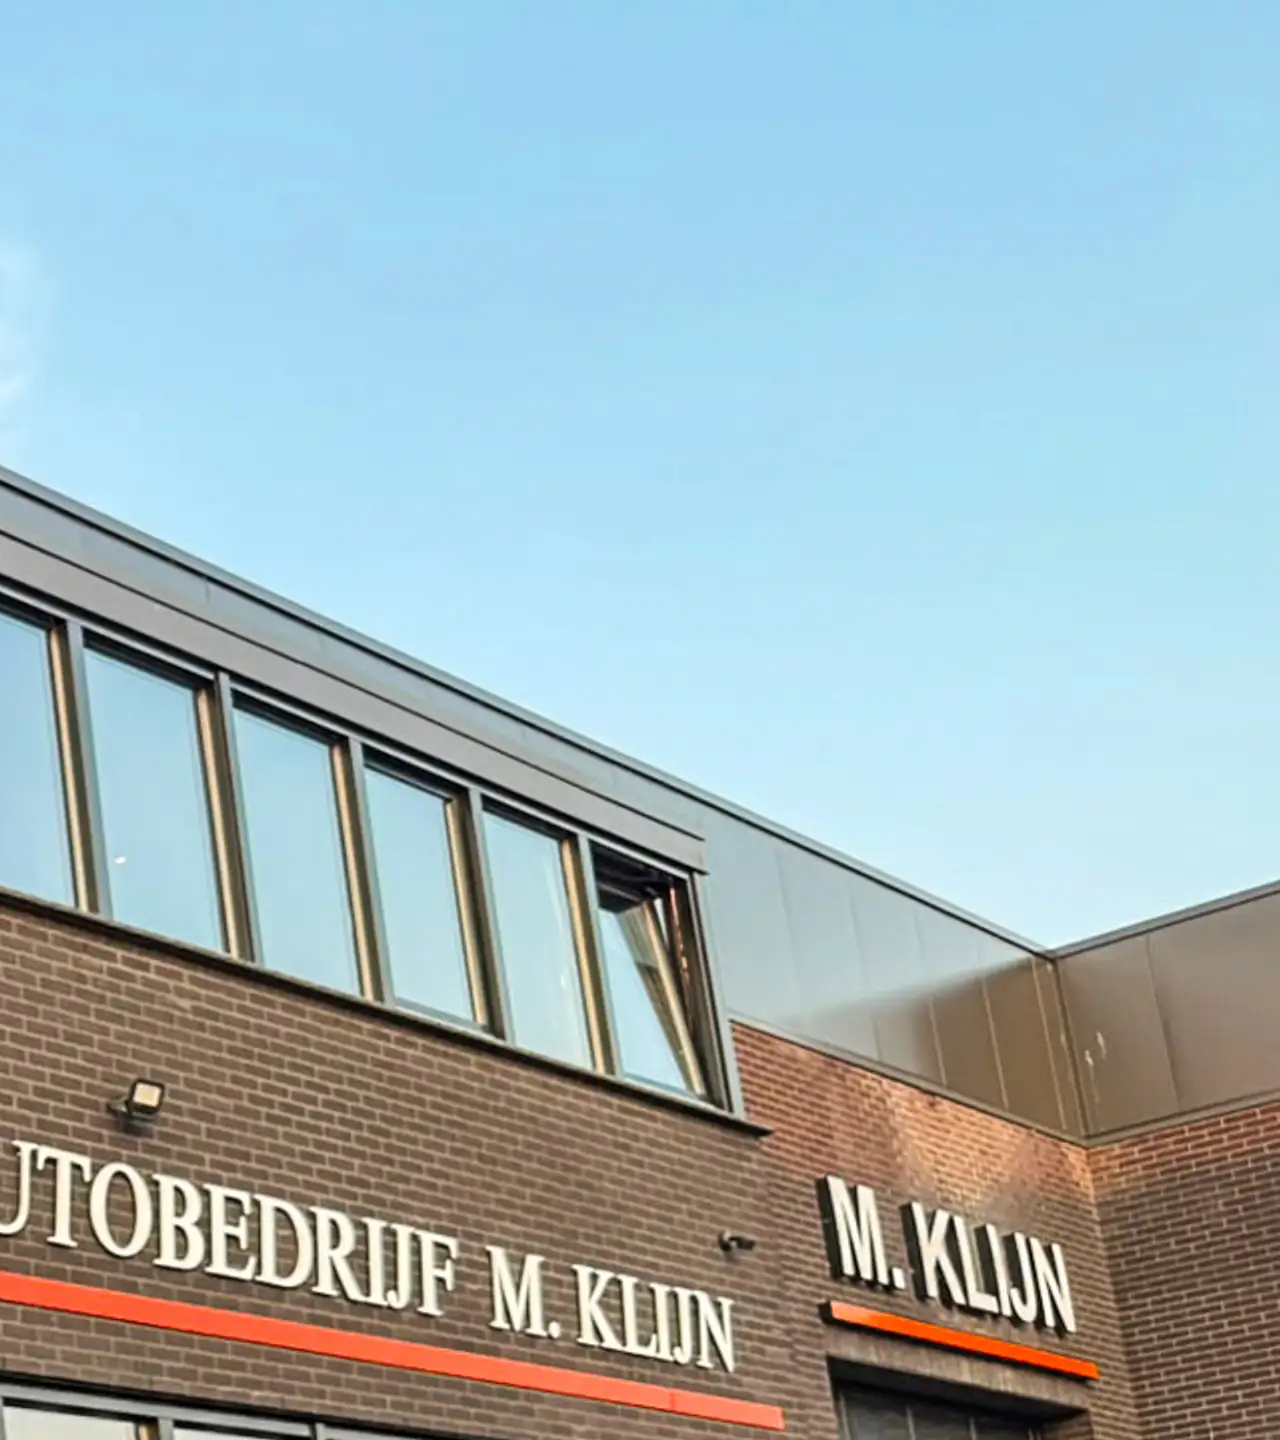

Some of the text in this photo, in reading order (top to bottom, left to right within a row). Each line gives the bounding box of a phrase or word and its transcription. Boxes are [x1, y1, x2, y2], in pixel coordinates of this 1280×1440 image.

[484, 1244, 561, 1339] M.
[574, 1263, 735, 1373] KLIJN
[819, 1175, 1078, 1336] M. KLIJN
